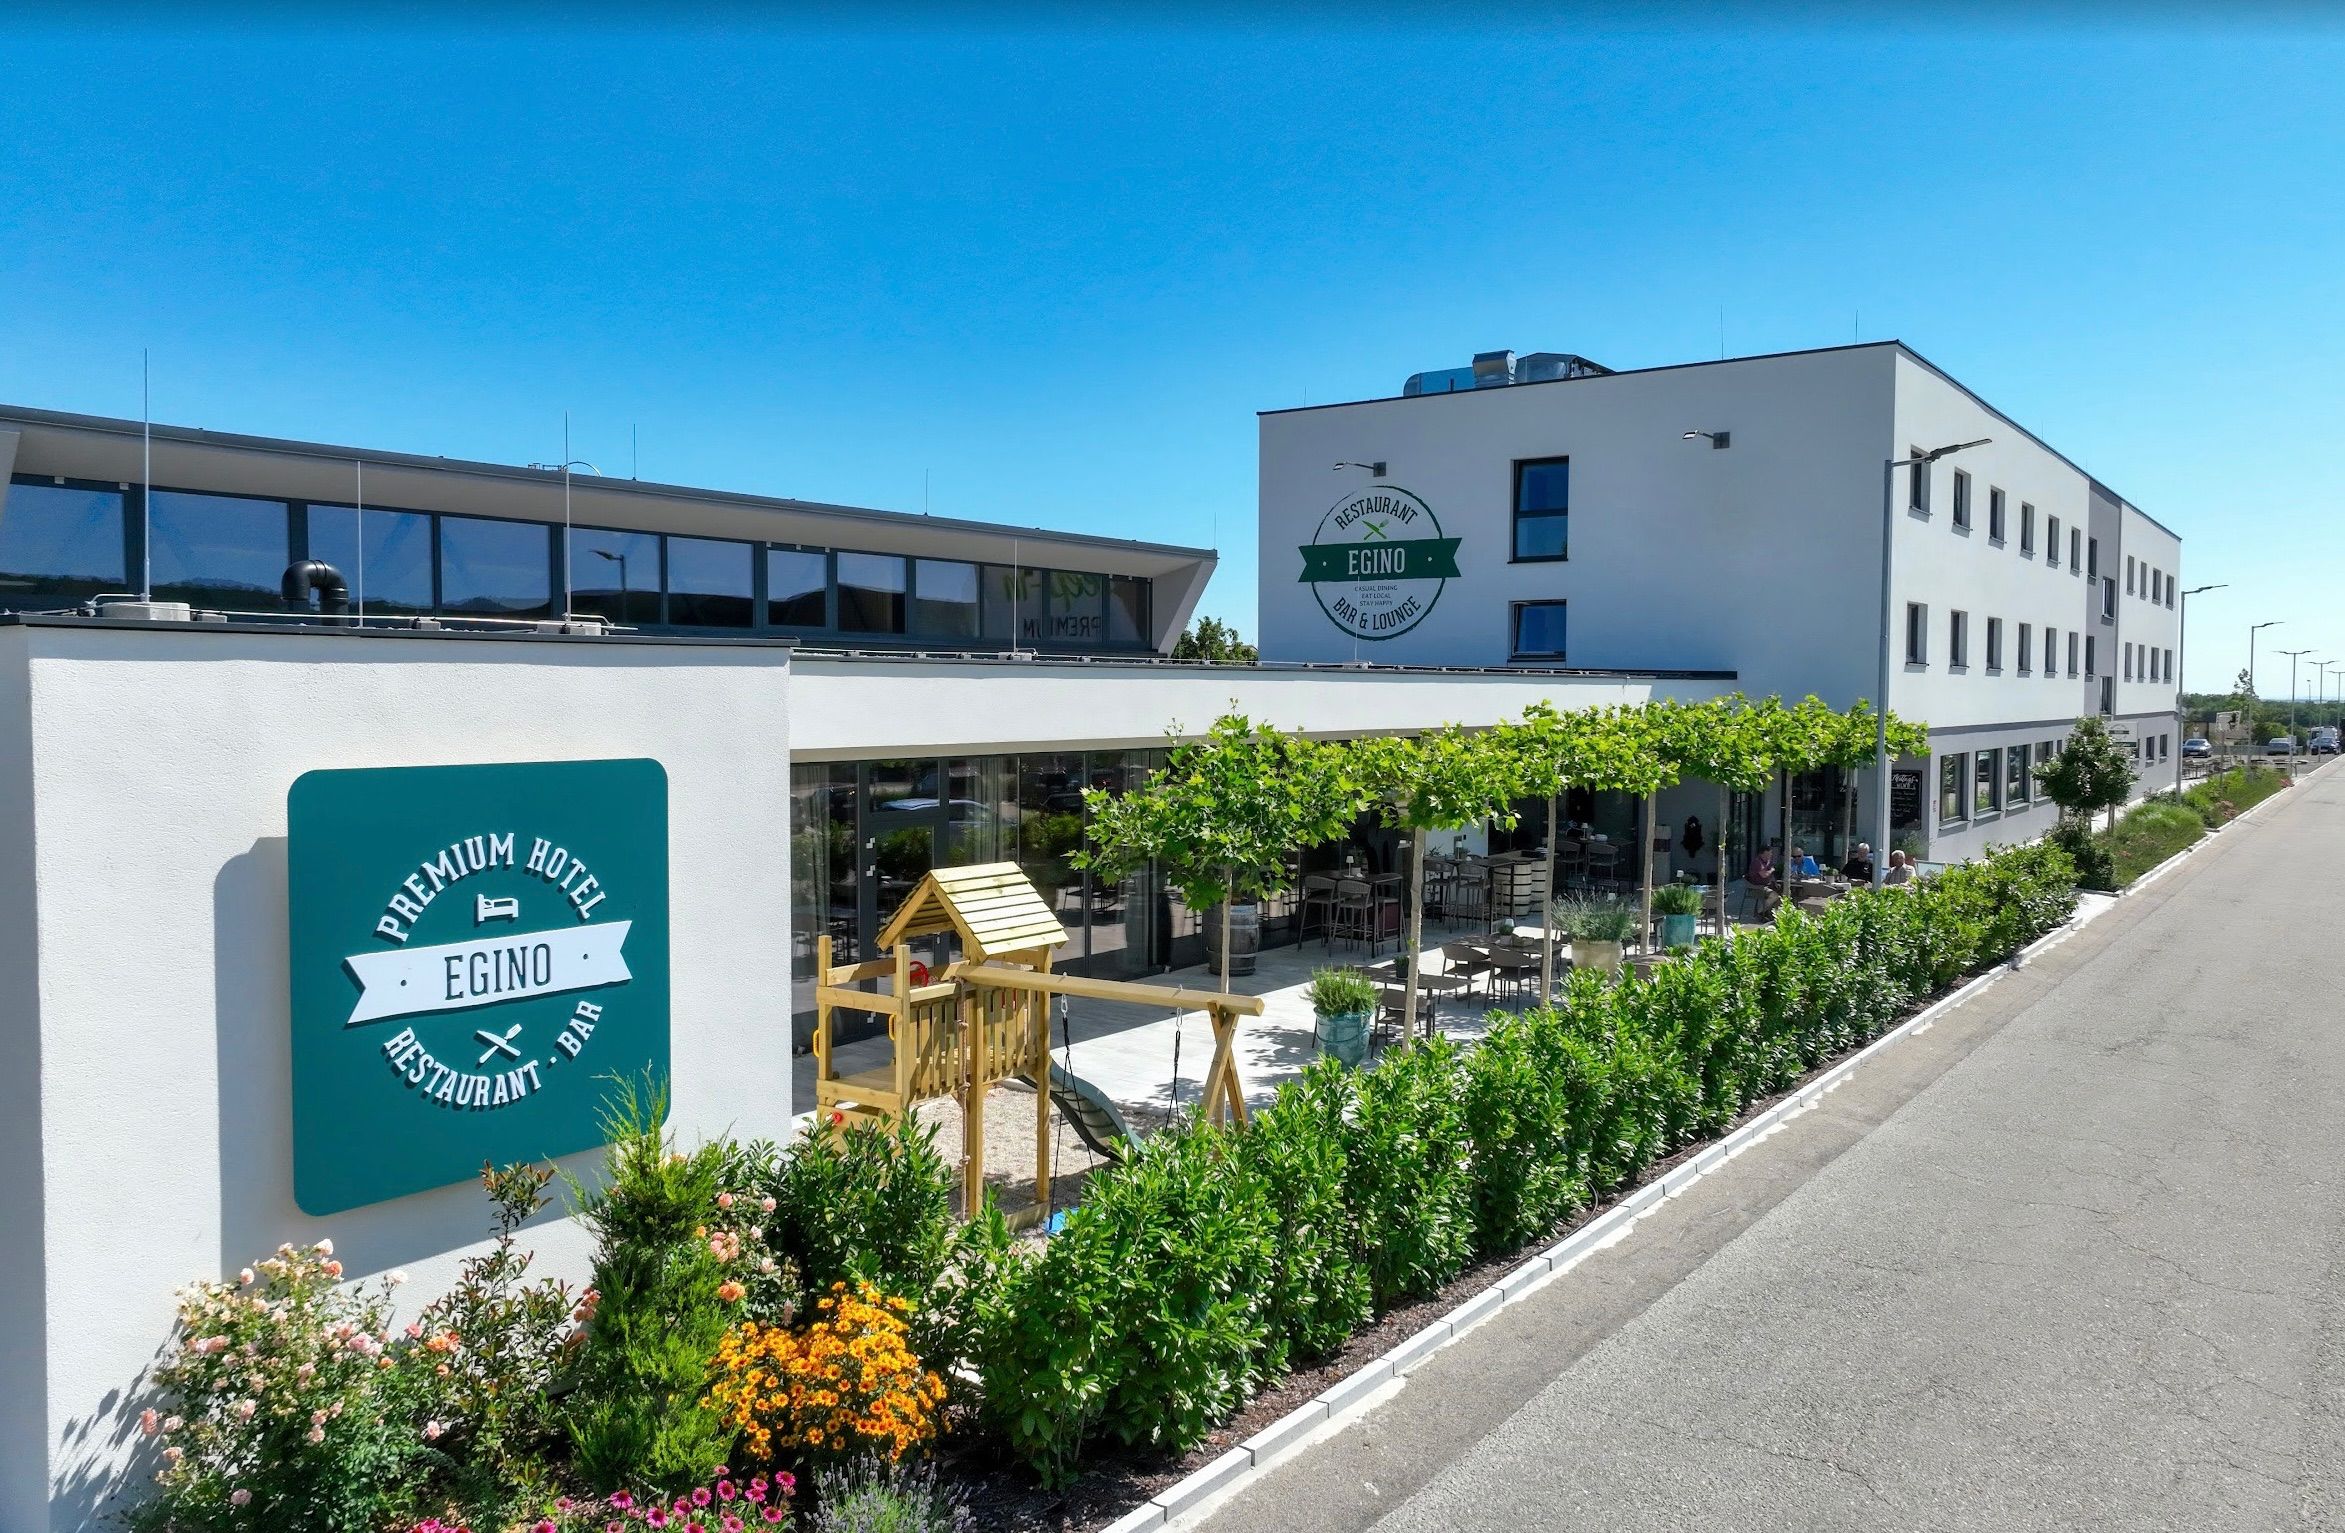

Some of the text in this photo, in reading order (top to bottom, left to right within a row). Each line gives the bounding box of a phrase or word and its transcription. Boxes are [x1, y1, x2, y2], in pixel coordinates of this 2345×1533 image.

[1334, 496, 1418, 530] RESTAURANT
[1348, 547, 1406, 575] EGINO
[1333, 596, 1421, 631] BAR & LOUNGE
[375, 832, 607, 942] PREMIUM HOTEL
[444, 943, 552, 1001] EGINO
[384, 1000, 603, 1107] RESTAURANT BAR
